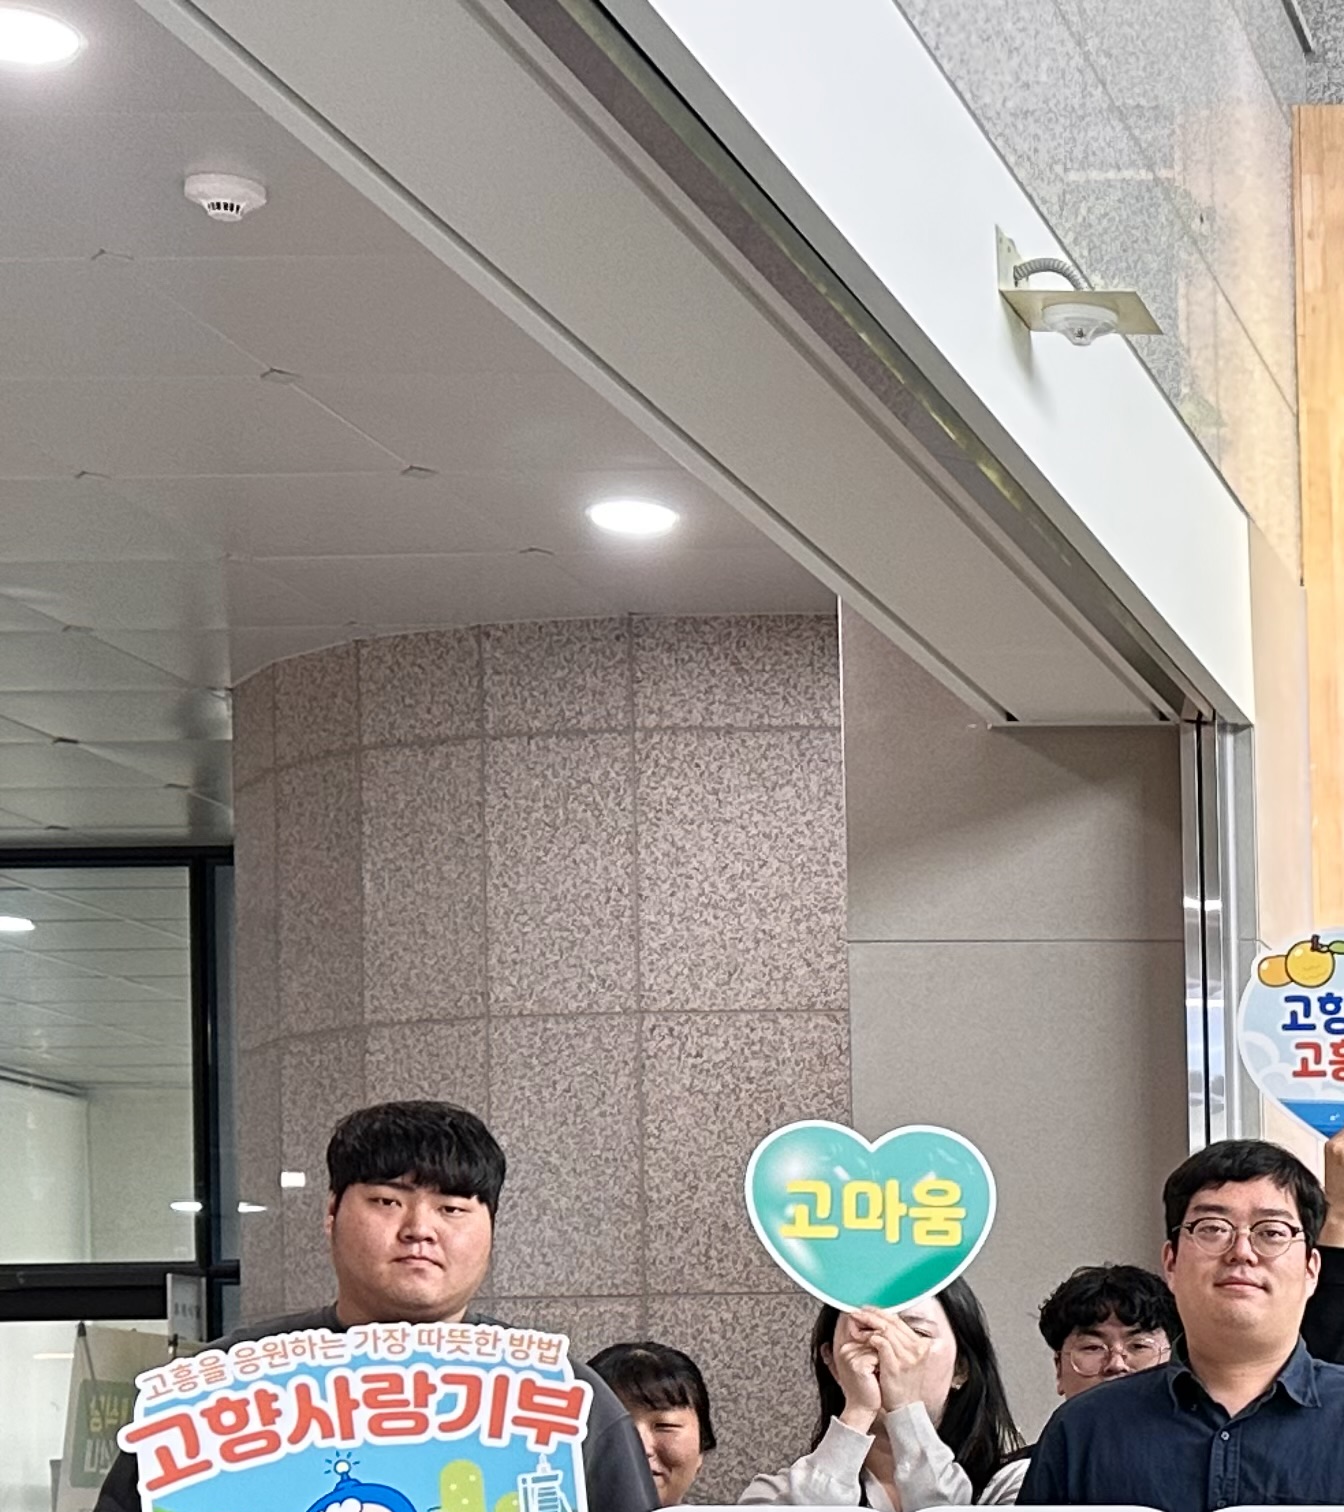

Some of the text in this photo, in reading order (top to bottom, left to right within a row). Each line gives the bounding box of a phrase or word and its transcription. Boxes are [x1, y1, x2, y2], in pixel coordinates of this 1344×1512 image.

[779, 1178, 967, 1247] 고마움
[143, 1327, 563, 1400] 고흥을 응원하는 가장 따뜻한 방법
[125, 1369, 586, 1491] 고향사랑기부
